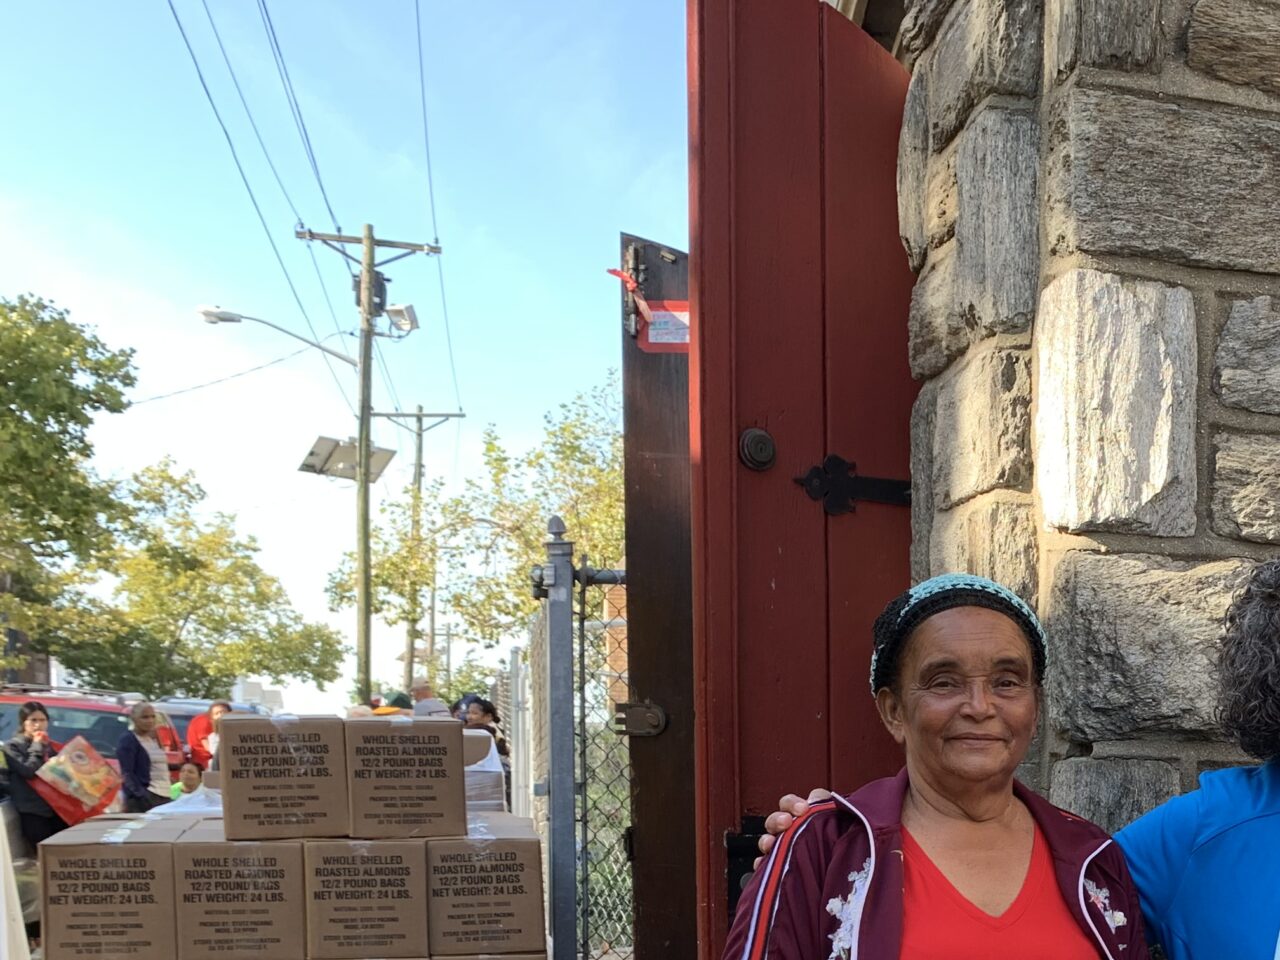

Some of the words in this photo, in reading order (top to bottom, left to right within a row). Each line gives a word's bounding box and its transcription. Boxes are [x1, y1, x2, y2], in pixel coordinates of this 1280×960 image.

[362, 735, 396, 744] WHOLE
[399, 735, 440, 744] SHELLED
[355, 746, 399, 756] ROASTED
[401, 746, 448, 756] ALMONDS
[360, 758, 380, 767] 12/2
[383, 758, 416, 767] POUND
[418, 758, 443, 767] BAGS
[354, 769, 372, 779] NET
[375, 769, 414, 779] WEIGHT:
[416, 769, 427, 778] 24
[429, 769, 450, 778] LBS.
[322, 856, 357, 865] WHOLE
[360, 855, 403, 865] SHELLED
[315, 867, 360, 877] ROASTED
[363, 866, 411, 877] ALMONDS
[320, 879, 341, 888] 12/2
[344, 879, 377, 888] POUND
[380, 878, 406, 888] BAGS
[314, 891, 332, 900] NET
[335, 890, 375, 900] WEIGHT:
[377, 890, 389, 899] 24
[391, 889, 413, 899] LBS.
